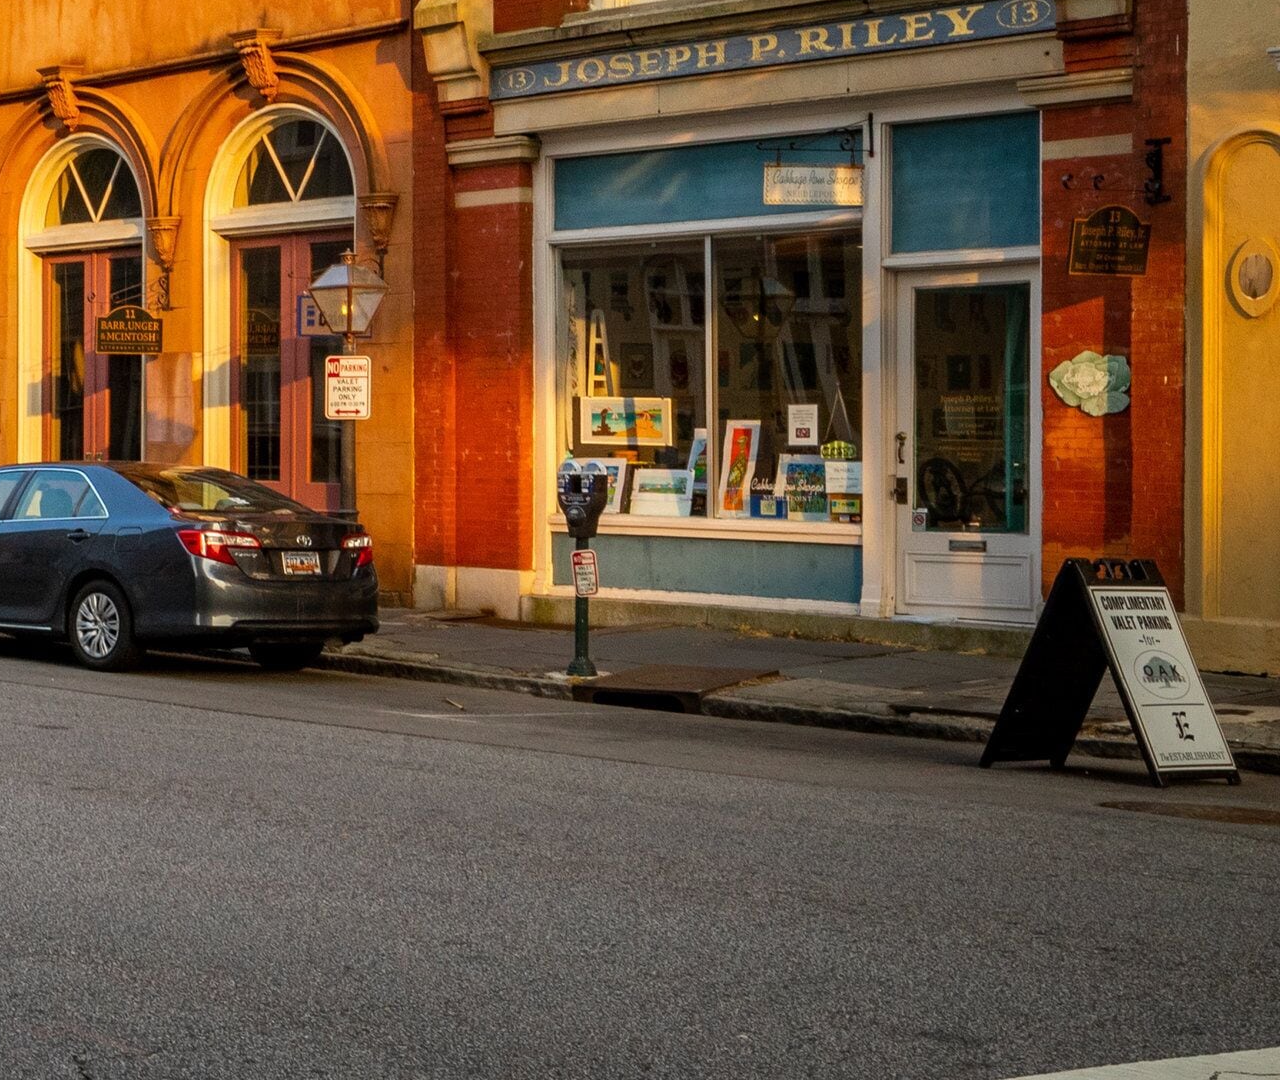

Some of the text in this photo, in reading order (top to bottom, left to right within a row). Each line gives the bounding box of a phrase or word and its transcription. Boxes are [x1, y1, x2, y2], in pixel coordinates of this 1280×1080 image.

[1010, 0, 1039, 25] 13
[544, 5, 984, 87] JOSEPH P. RILEY
[508, 71, 526, 89] 13
[125, 309, 136, 319] 11
[328, 361, 367, 374] NO PARKING
[1100, 596, 1167, 610] COMPLIMENTARY
[1111, 615, 1172, 630] VALET PARKING
[1143, 664, 1181, 677] OAK
[1170, 751, 1225, 761] ESTABLISHMENT
